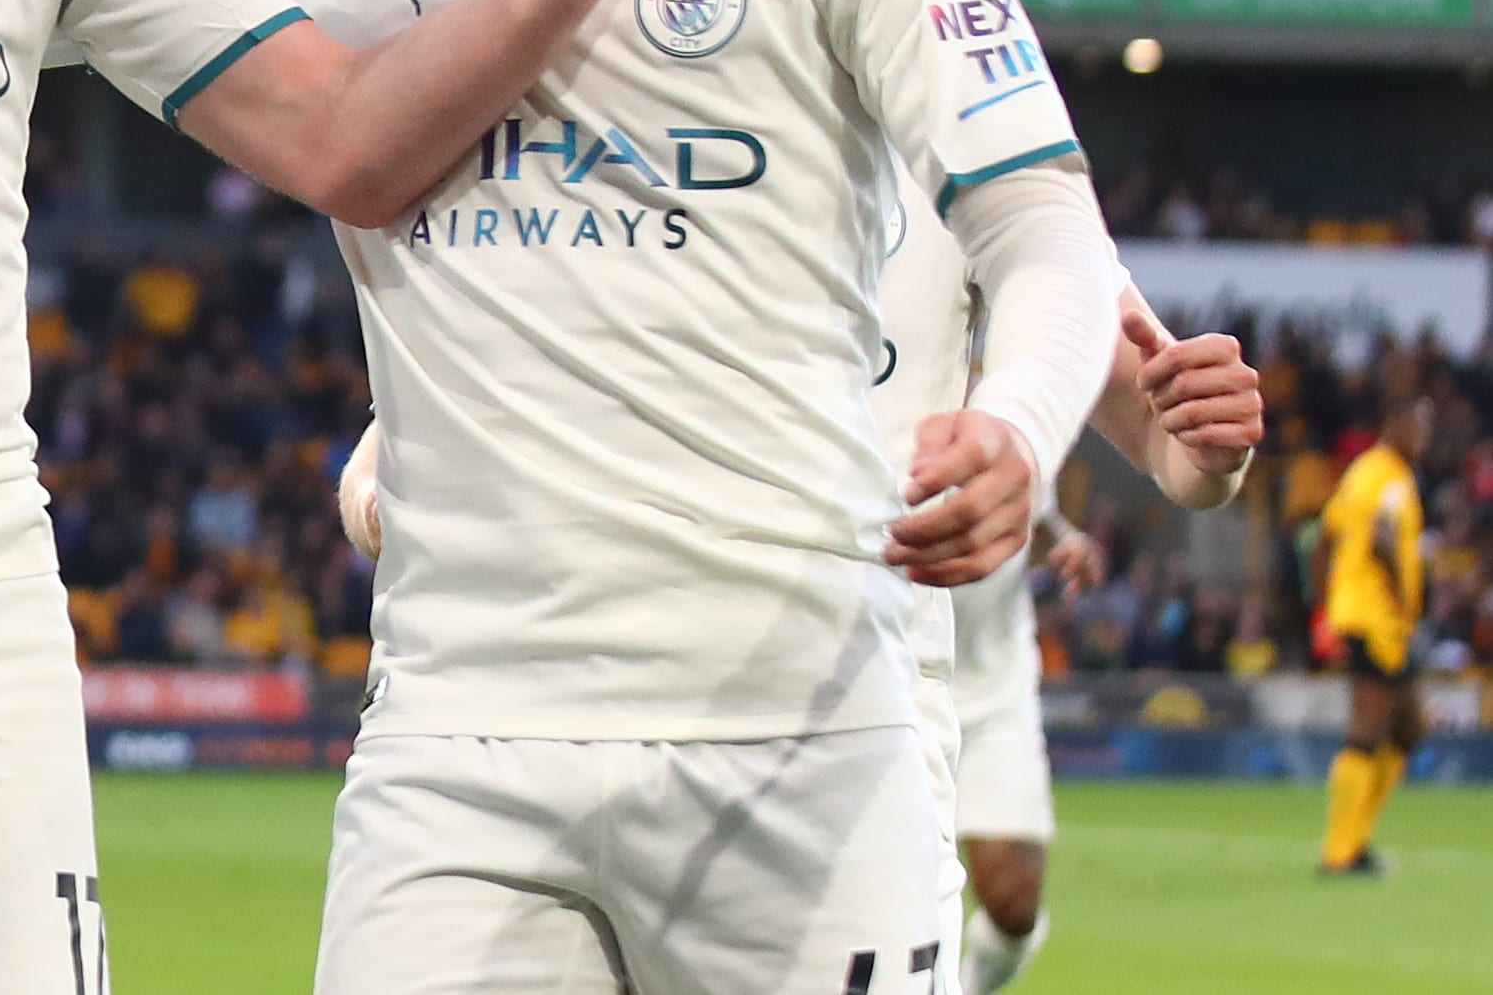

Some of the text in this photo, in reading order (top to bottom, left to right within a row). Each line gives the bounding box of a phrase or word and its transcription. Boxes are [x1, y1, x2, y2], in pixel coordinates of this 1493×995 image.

[669, 37, 701, 49] CITY
[479, 118, 768, 191] IHAD
[409, 207, 688, 250] AIRWAYS
